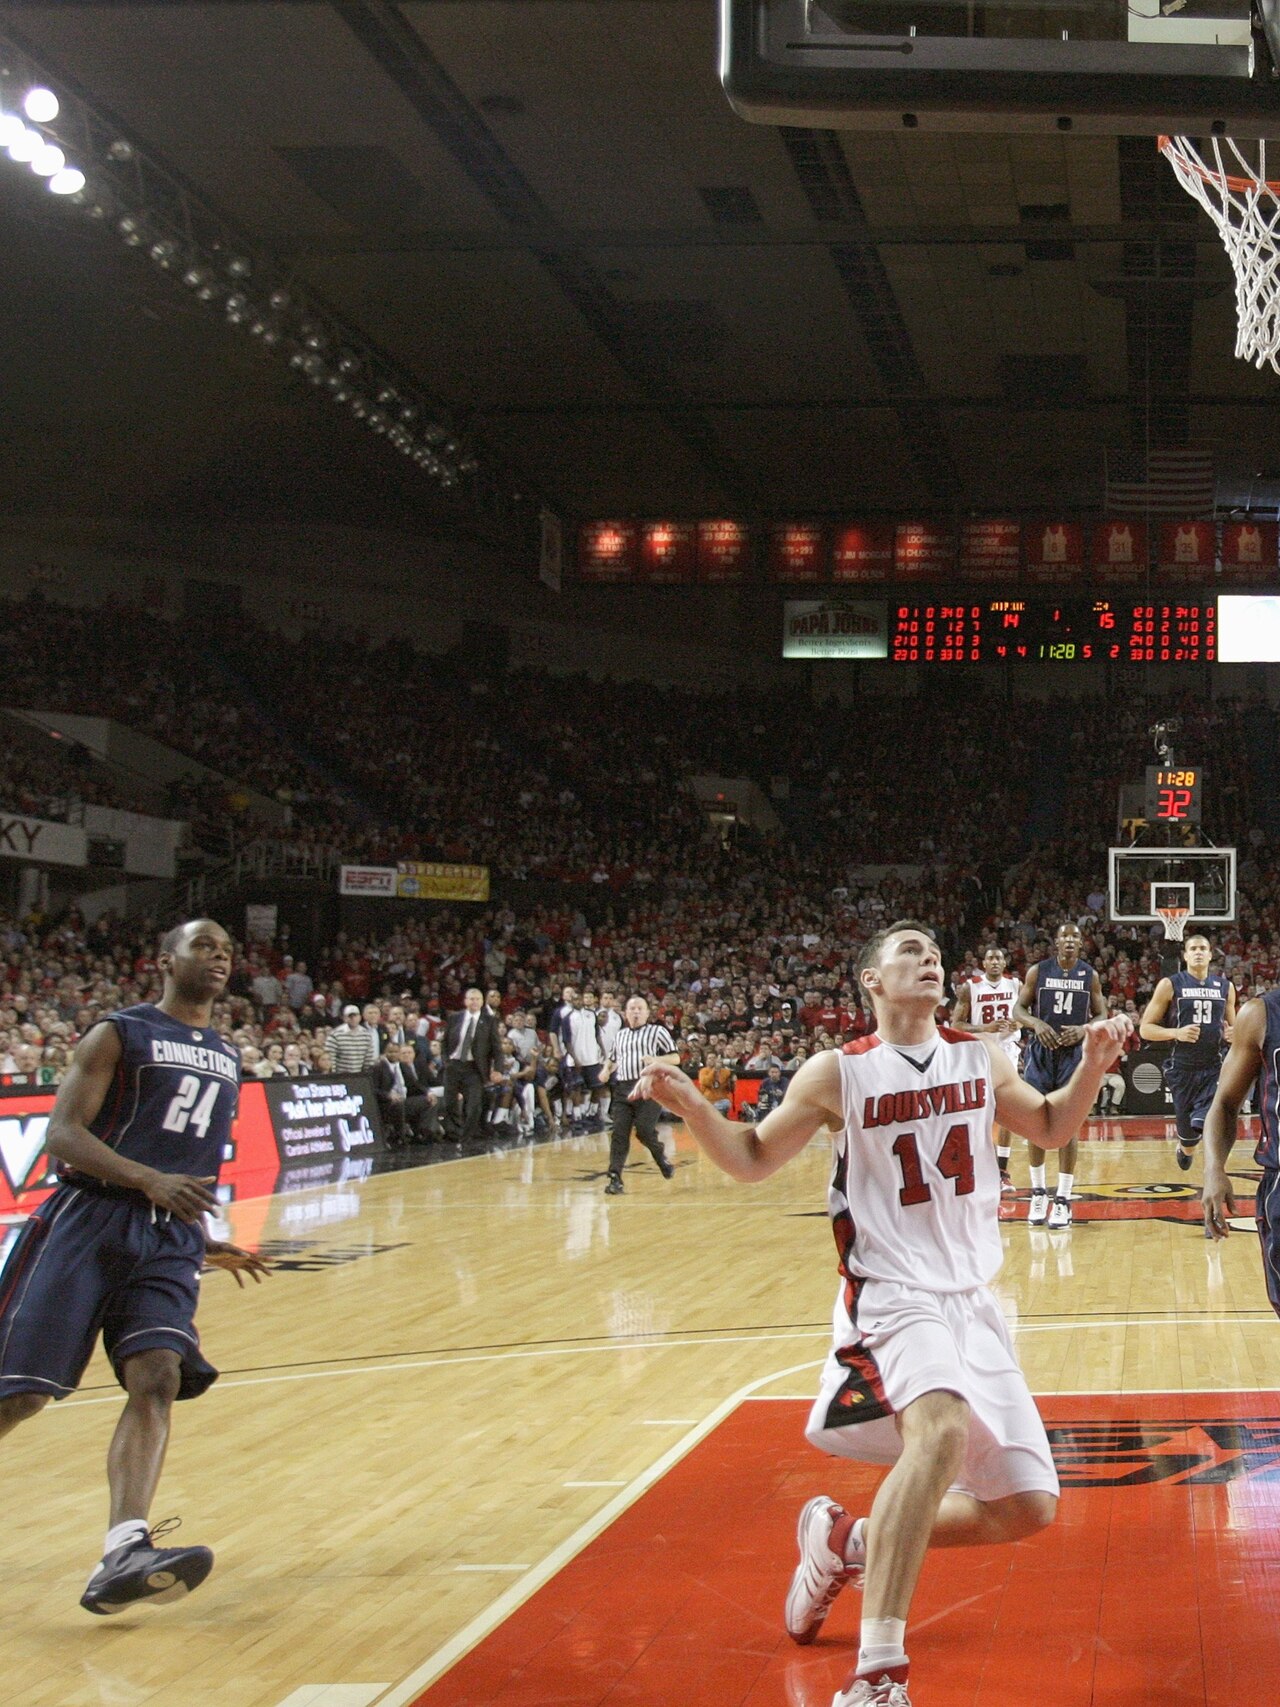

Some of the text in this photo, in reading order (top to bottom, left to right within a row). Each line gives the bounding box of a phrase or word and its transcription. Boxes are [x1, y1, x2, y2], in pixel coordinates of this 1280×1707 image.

[1099, 612, 1115, 629] 15
[1040, 644, 1075, 659] 11:28
[1157, 771, 1195, 786] 11:28
[1157, 790, 1192, 817] 32
[1046, 978, 1084, 990] CONNECTICUT
[1182, 988, 1221, 998] CONNECTICUT
[977, 992, 1012, 1002] LOUISVILLE
[1053, 991, 1073, 1015] 34
[1193, 1000, 1212, 1024] 33
[152, 1040, 238, 1082] CONNECTICUT
[162, 1075, 221, 1138] 24
[863, 1078, 986, 1129] LOUISVILLE
[892, 1124, 976, 1206] 14
